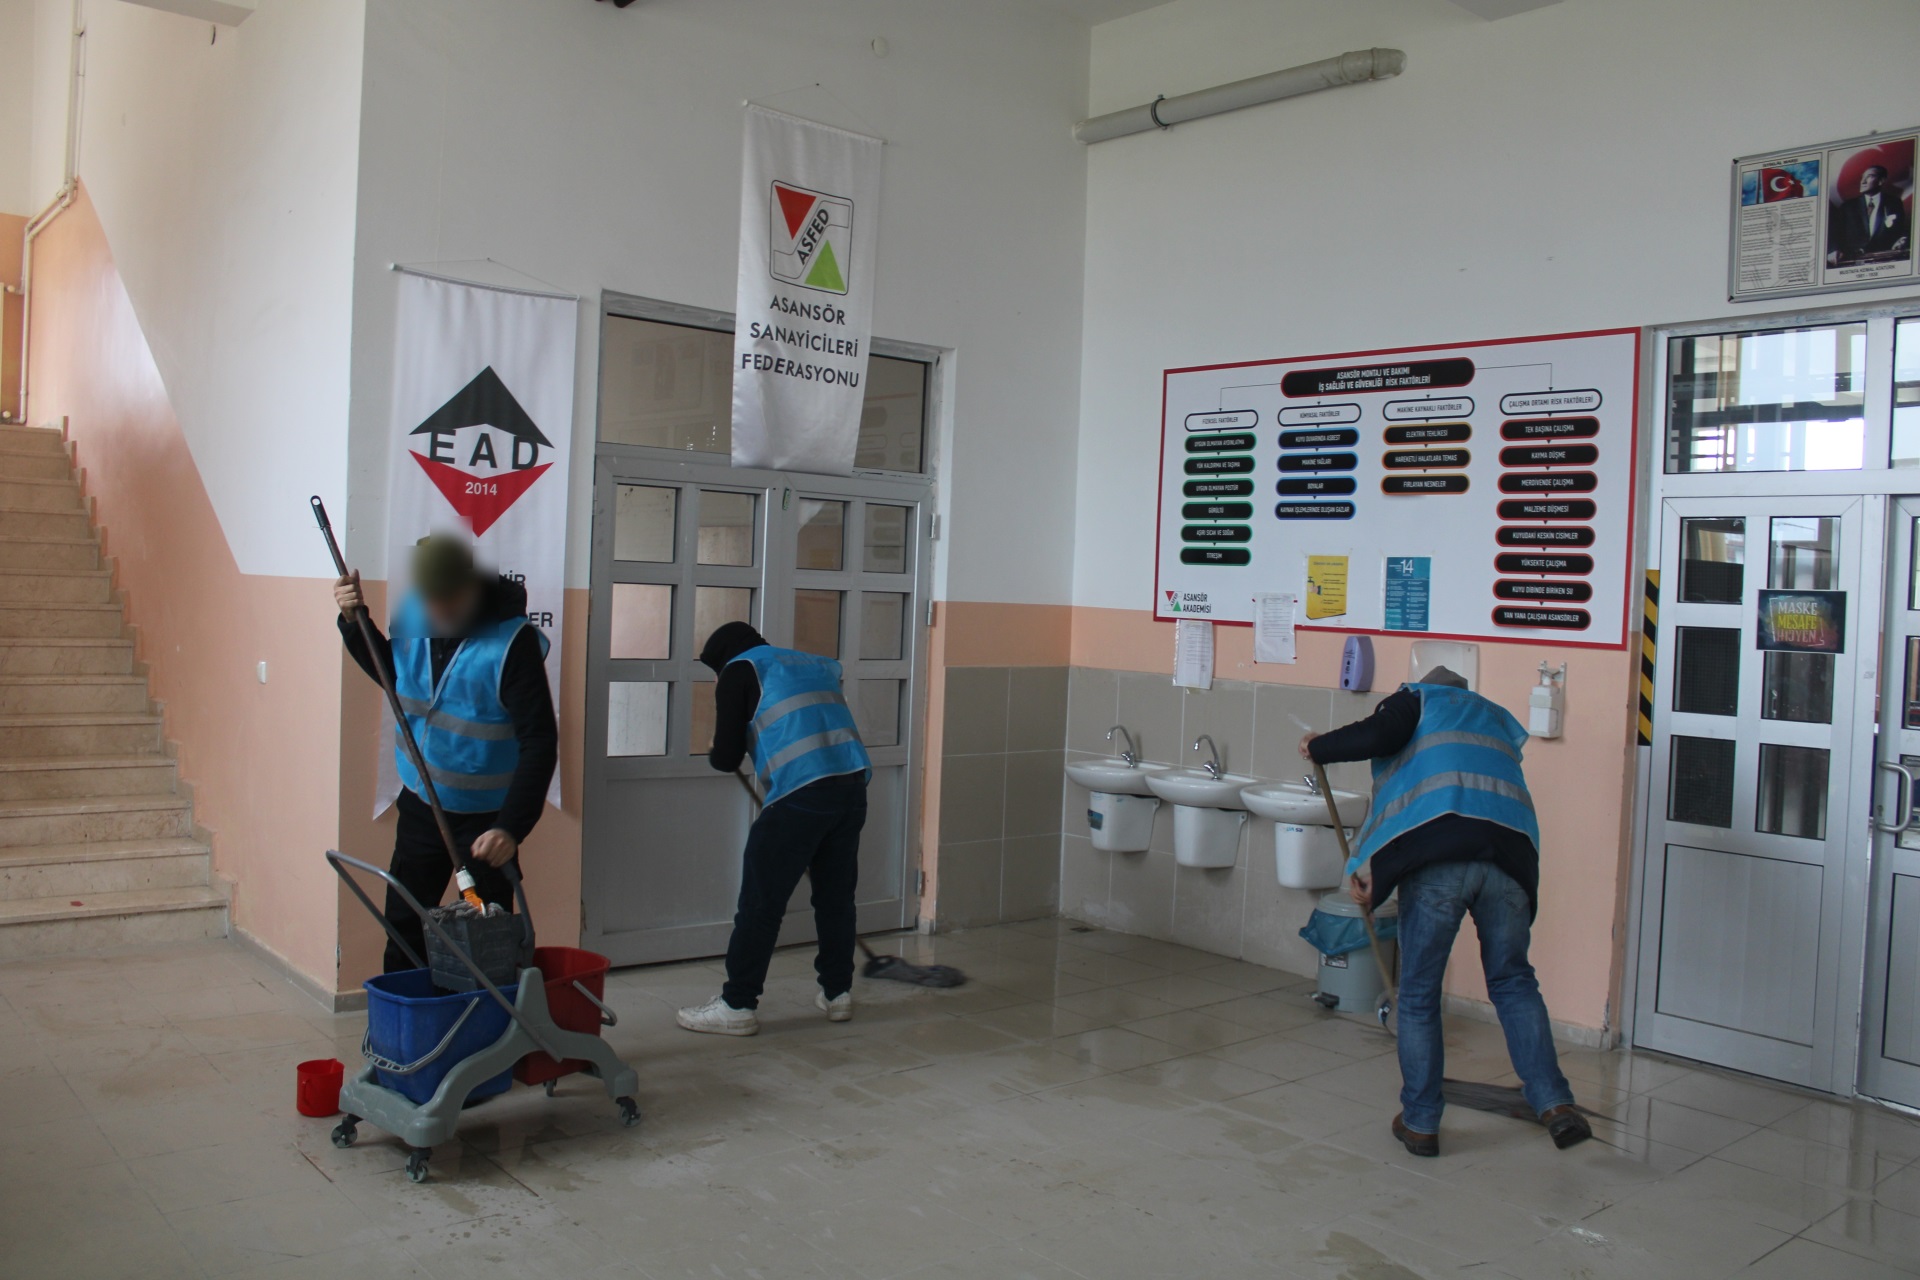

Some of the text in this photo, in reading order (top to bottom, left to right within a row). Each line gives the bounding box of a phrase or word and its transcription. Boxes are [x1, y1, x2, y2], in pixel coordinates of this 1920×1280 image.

[797, 208, 829, 266] ASFED
[770, 294, 845, 325] ASANSÖR
[750, 322, 858, 357] SANAYİCİLERİ
[742, 353, 859, 388] FEDERASYONU
[1336, 366, 1410, 379] ASANSÖR MONTAJ VE BAKIMI
[1318, 374, 1431, 393] İŞ SAĞLIĞI VE GÜVENLİĞİ RİSK FAKTÖRLERİ
[1509, 400, 1530, 408] ÇALIŞMA
[1564, 396, 1593, 404] FAKTÖRLERİ
[1406, 429, 1448, 438] ELEKTRİK TEHLİKESİ
[1535, 426, 1552, 434] BAŞINA
[1553, 425, 1575, 433] ÇALIŞMA
[429, 429, 539, 470] EAD
[1548, 451, 1566, 459] DÜŞME
[465, 481, 497, 496] 2014
[1307, 482, 1324, 490] BOYALAR
[1553, 479, 1574, 487] ÇALIŞMA
[1547, 505, 1569, 514] DÜŞMESİ
[1513, 531, 1536, 539] KUYUDAKİ
[1400, 559, 1414, 574] 14
[1521, 558, 1567, 568] YÜKSEKTE ÇALIŞMA
[1526, 586, 1545, 594] DİBİNDE
[1546, 586, 1565, 595] BİRİKEN
[1566, 587, 1573, 595] SU
[1183, 592, 1208, 602] ASANSÖR
[1183, 603, 1212, 613] AKADEMİSİ
[1778, 601, 1818, 615] MASKE
[1504, 611, 1580, 622] YAN YANA ÇALIŞAN ASANSÖRLER
[1777, 614, 1817, 630] MESAFE
